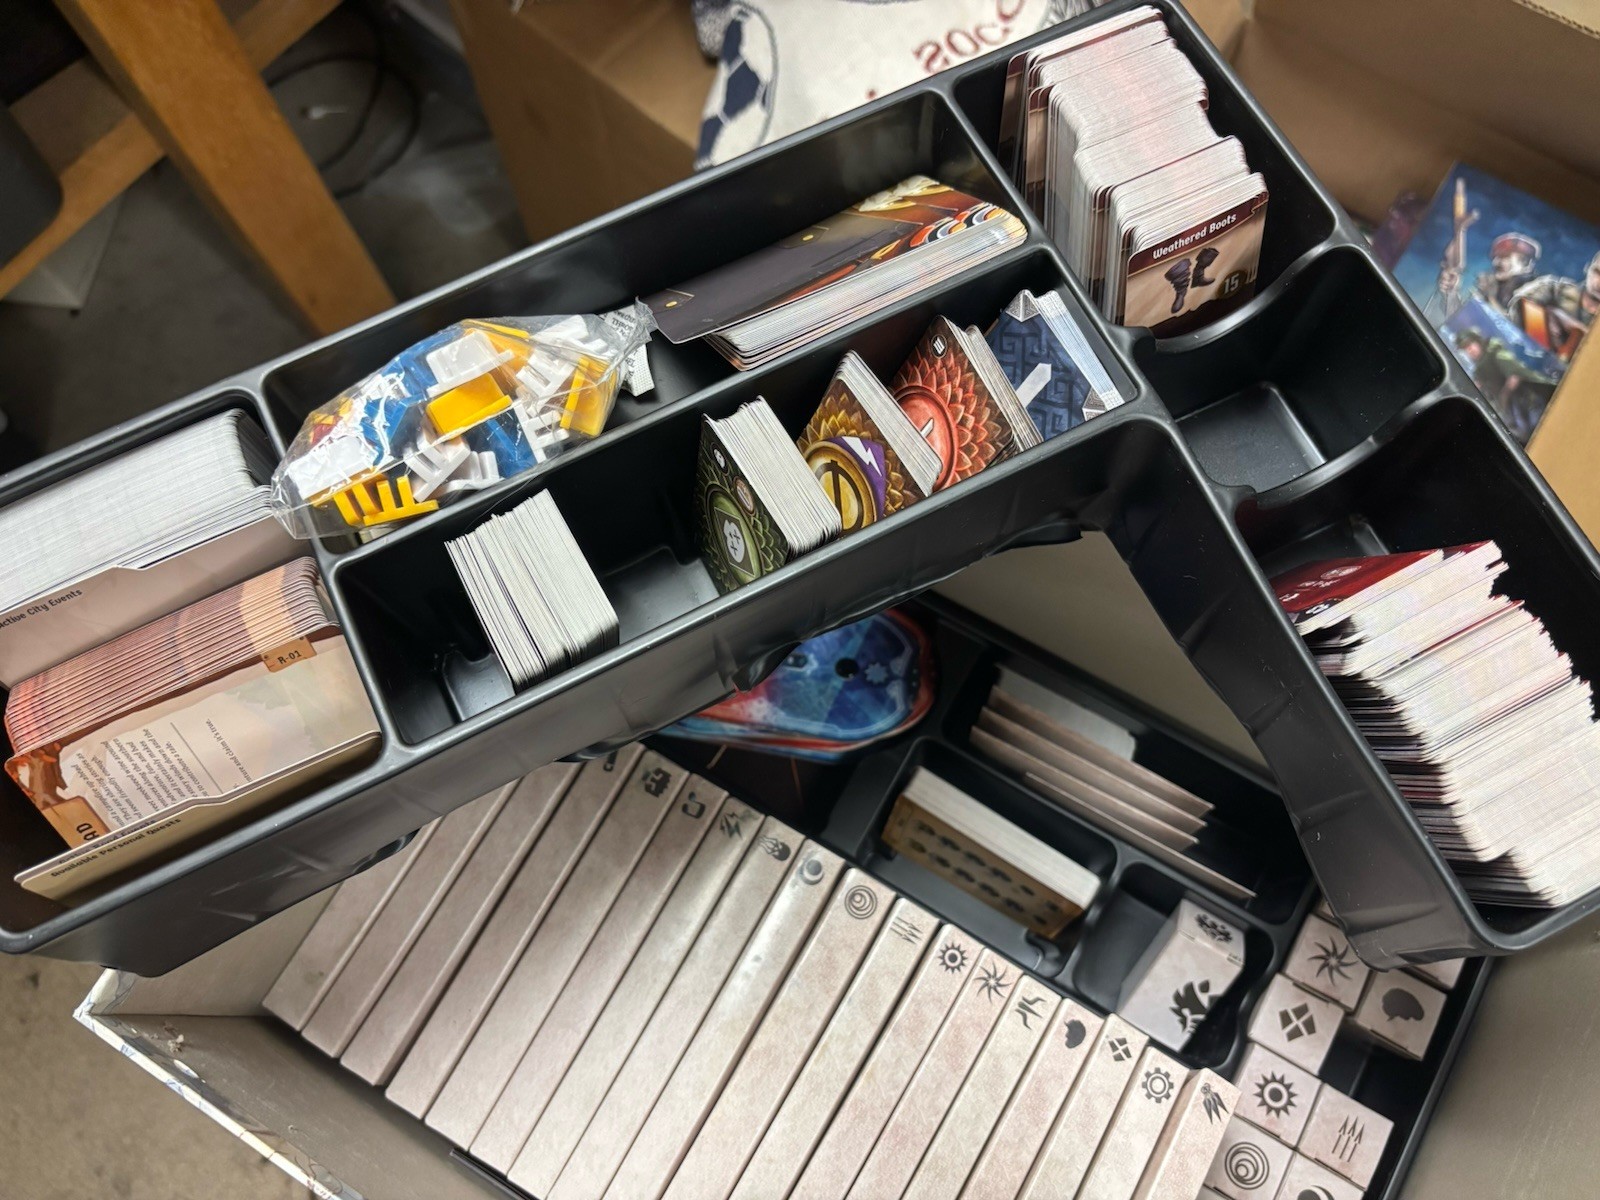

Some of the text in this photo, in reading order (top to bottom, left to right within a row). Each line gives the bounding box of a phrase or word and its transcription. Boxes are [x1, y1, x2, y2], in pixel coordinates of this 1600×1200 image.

[1153, 213, 1237, 259] Weathered Boots
[1223, 273, 1239, 294] 15
[27, 602, 50, 616] City
[48, 589, 83, 607] Events
[277, 650, 302, 665] R-01
[50, 817, 181, 877] Available Personal Quests
